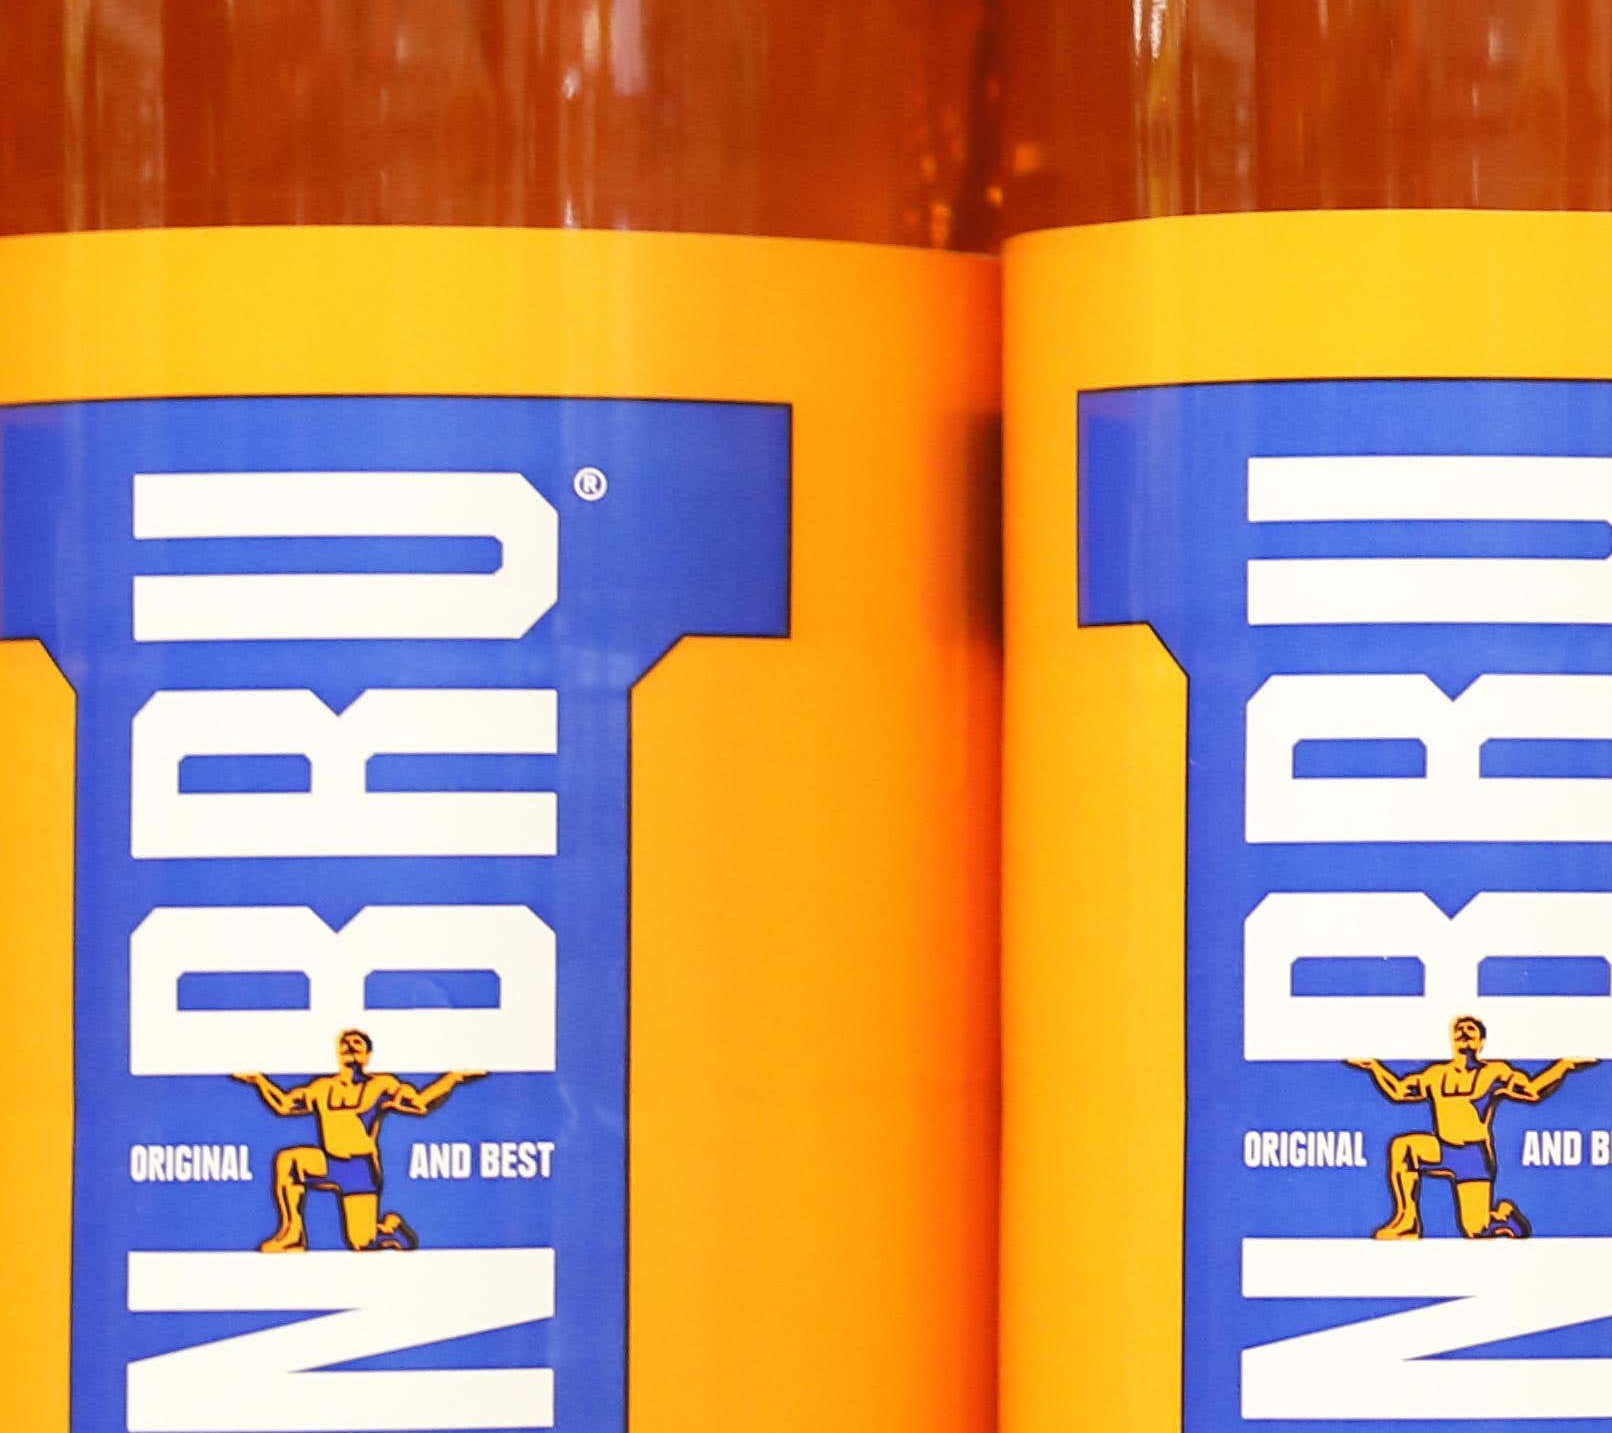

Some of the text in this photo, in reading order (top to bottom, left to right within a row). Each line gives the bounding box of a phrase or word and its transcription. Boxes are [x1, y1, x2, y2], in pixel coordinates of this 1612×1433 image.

[130, 472, 558, 1075] BRU
[131, 1142, 555, 1181] ORIGINAL AND BEST
[1244, 1131, 1367, 1167] ORIGINAL
[1522, 1131, 1581, 1166] AND
